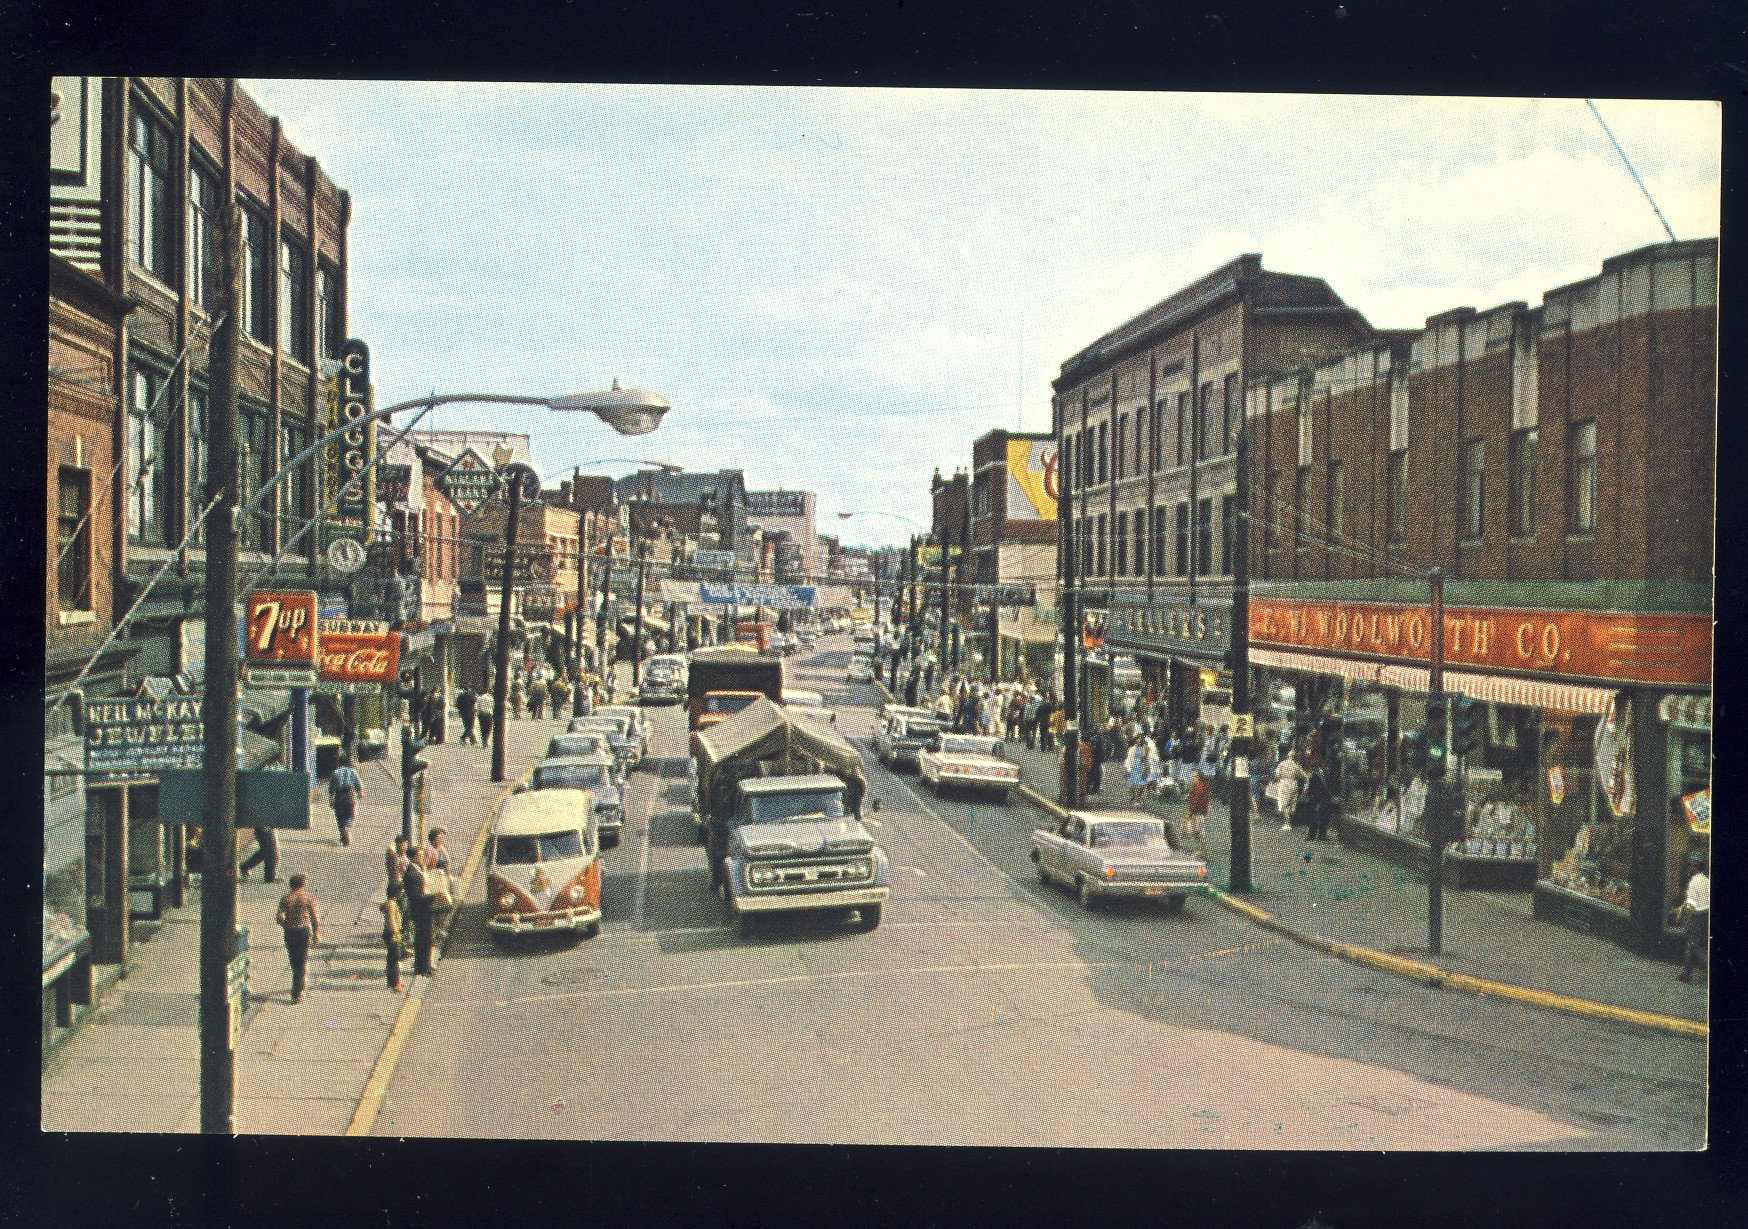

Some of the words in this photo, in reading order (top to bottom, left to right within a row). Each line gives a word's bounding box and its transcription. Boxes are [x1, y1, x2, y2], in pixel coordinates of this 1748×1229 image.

[1317, 610, 1490, 654] WOOLWOTH
[1516, 623, 1571, 661] CO.
[89, 702, 131, 723] NEIL
[1236, 717, 1248, 734] 2
